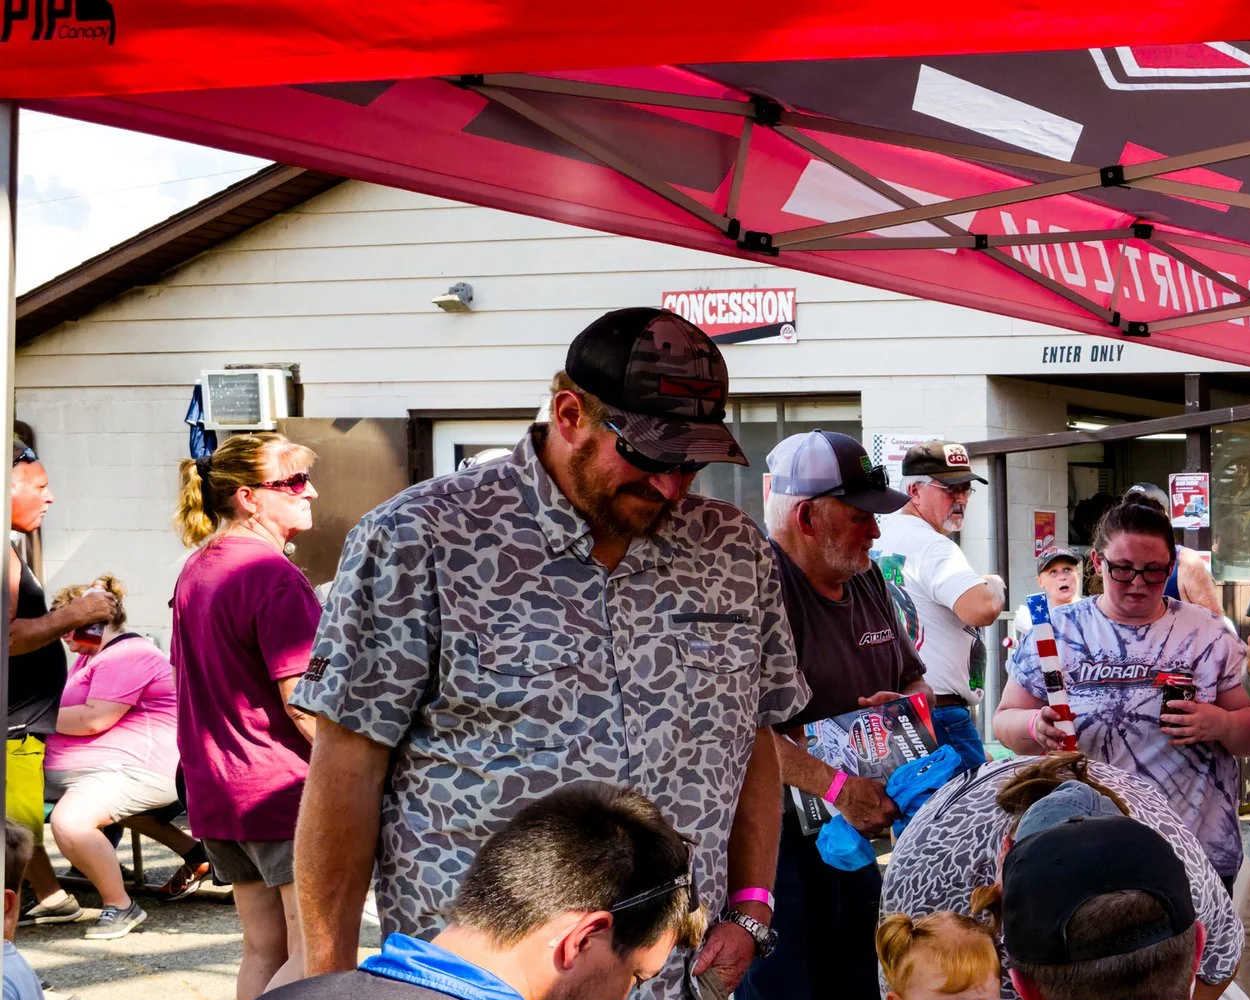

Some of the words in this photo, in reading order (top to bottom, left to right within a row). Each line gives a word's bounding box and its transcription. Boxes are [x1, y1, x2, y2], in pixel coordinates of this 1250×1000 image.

[58, 25, 110, 39] Canopy
[662, 291, 795, 325] CONCESSION
[1042, 346, 1082, 364] ENTER
[1090, 344, 1125, 362] ONLY
[1078, 662, 1151, 682] MORAN
